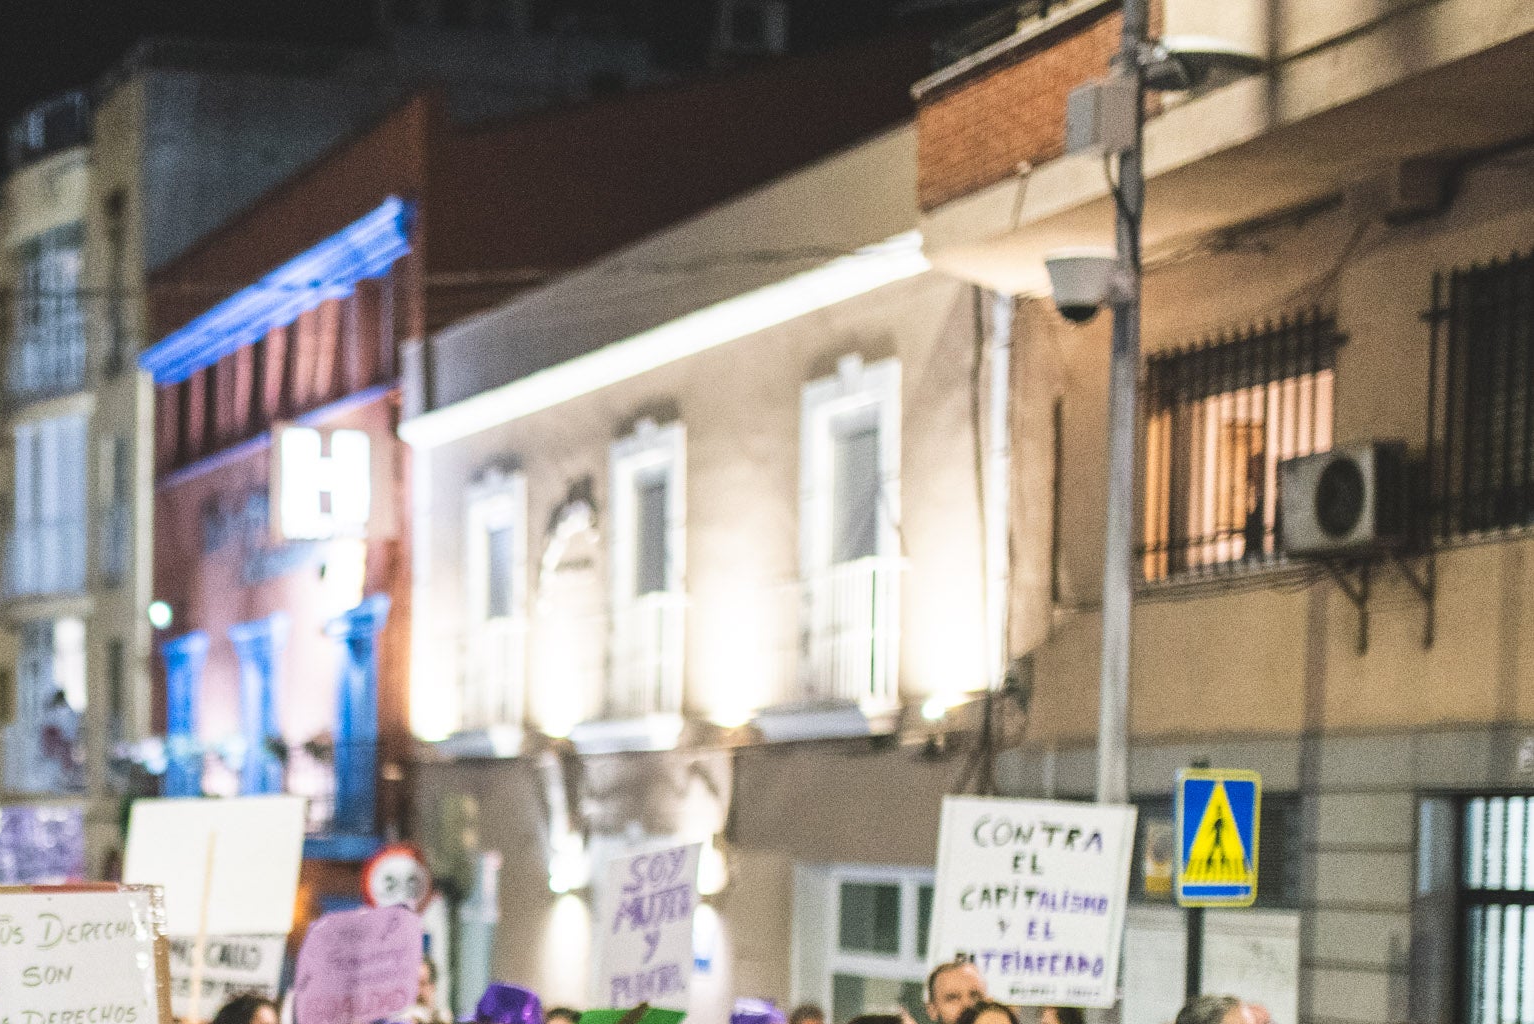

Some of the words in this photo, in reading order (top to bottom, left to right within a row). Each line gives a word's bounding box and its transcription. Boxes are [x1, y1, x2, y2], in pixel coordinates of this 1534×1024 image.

[973, 814, 1103, 851] CONTRA
[1012, 852, 1044, 876] EL
[1027, 918, 1055, 941] EL
[22, 965, 73, 988] SON
